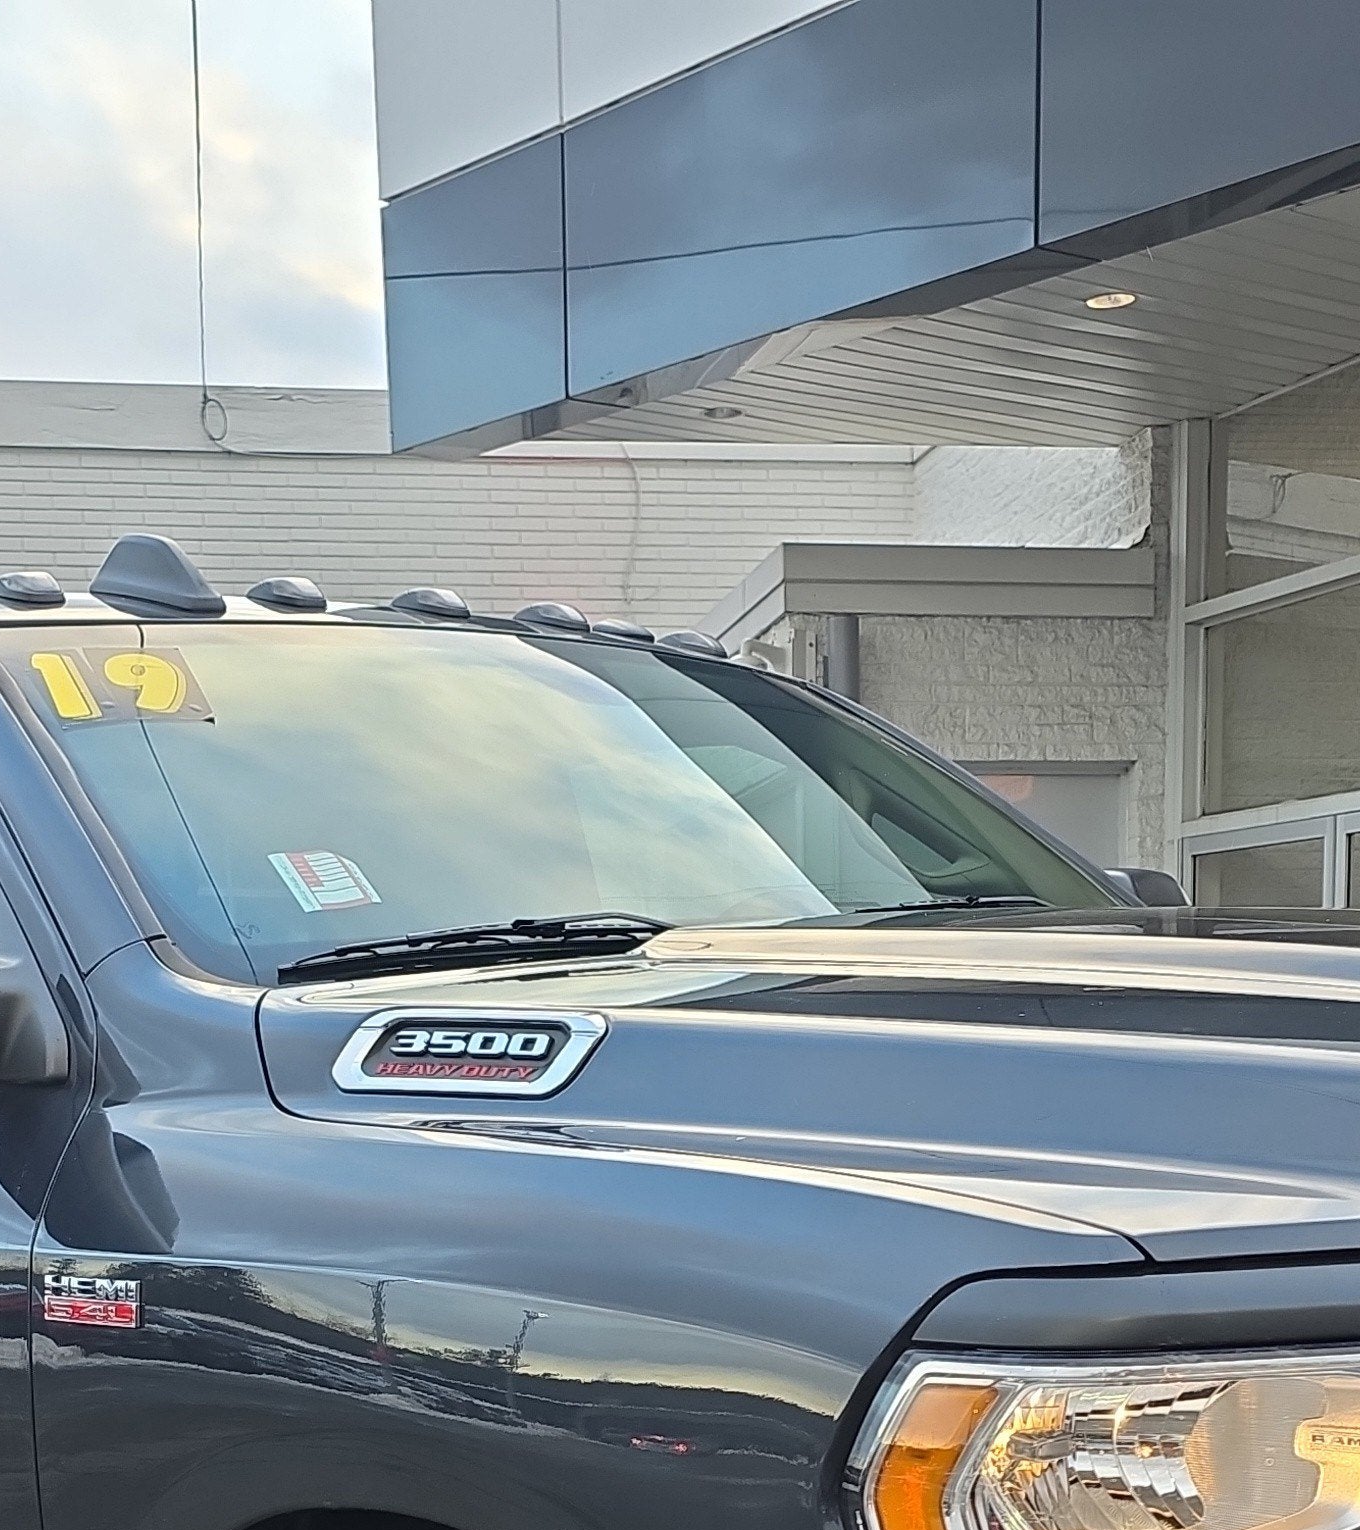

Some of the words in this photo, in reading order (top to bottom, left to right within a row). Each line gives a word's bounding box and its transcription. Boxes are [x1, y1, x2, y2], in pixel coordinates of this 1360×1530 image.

[29, 652, 189, 721] 19
[388, 1029, 554, 1060] 3500
[375, 1061, 461, 1077] HEAVY
[459, 1065, 540, 1079] DUTY
[43, 1274, 142, 1303] HEMI
